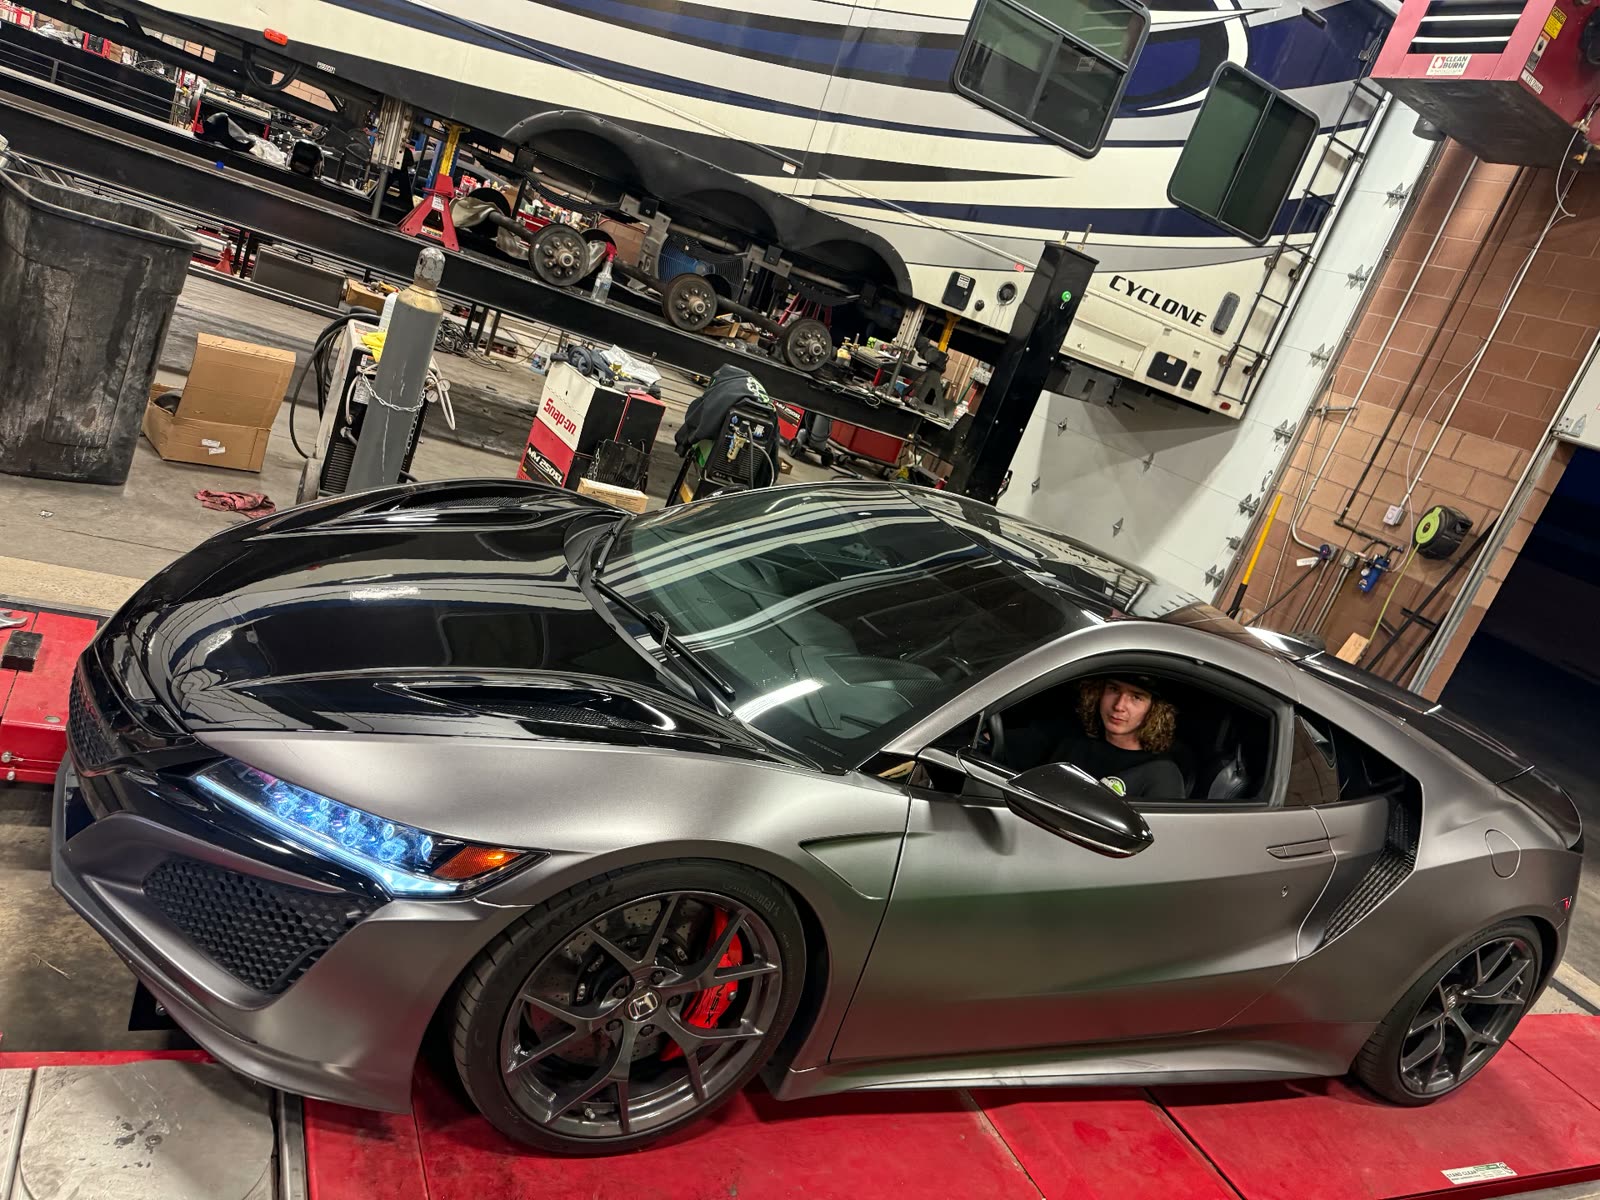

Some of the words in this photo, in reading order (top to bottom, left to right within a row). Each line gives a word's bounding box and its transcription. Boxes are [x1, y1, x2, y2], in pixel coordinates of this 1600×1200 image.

[1109, 275, 1207, 327] CYCLONE
[543, 398, 577, 435] Snap-on
[527, 447, 541, 462] MM
[539, 460, 563, 485] 250SL
